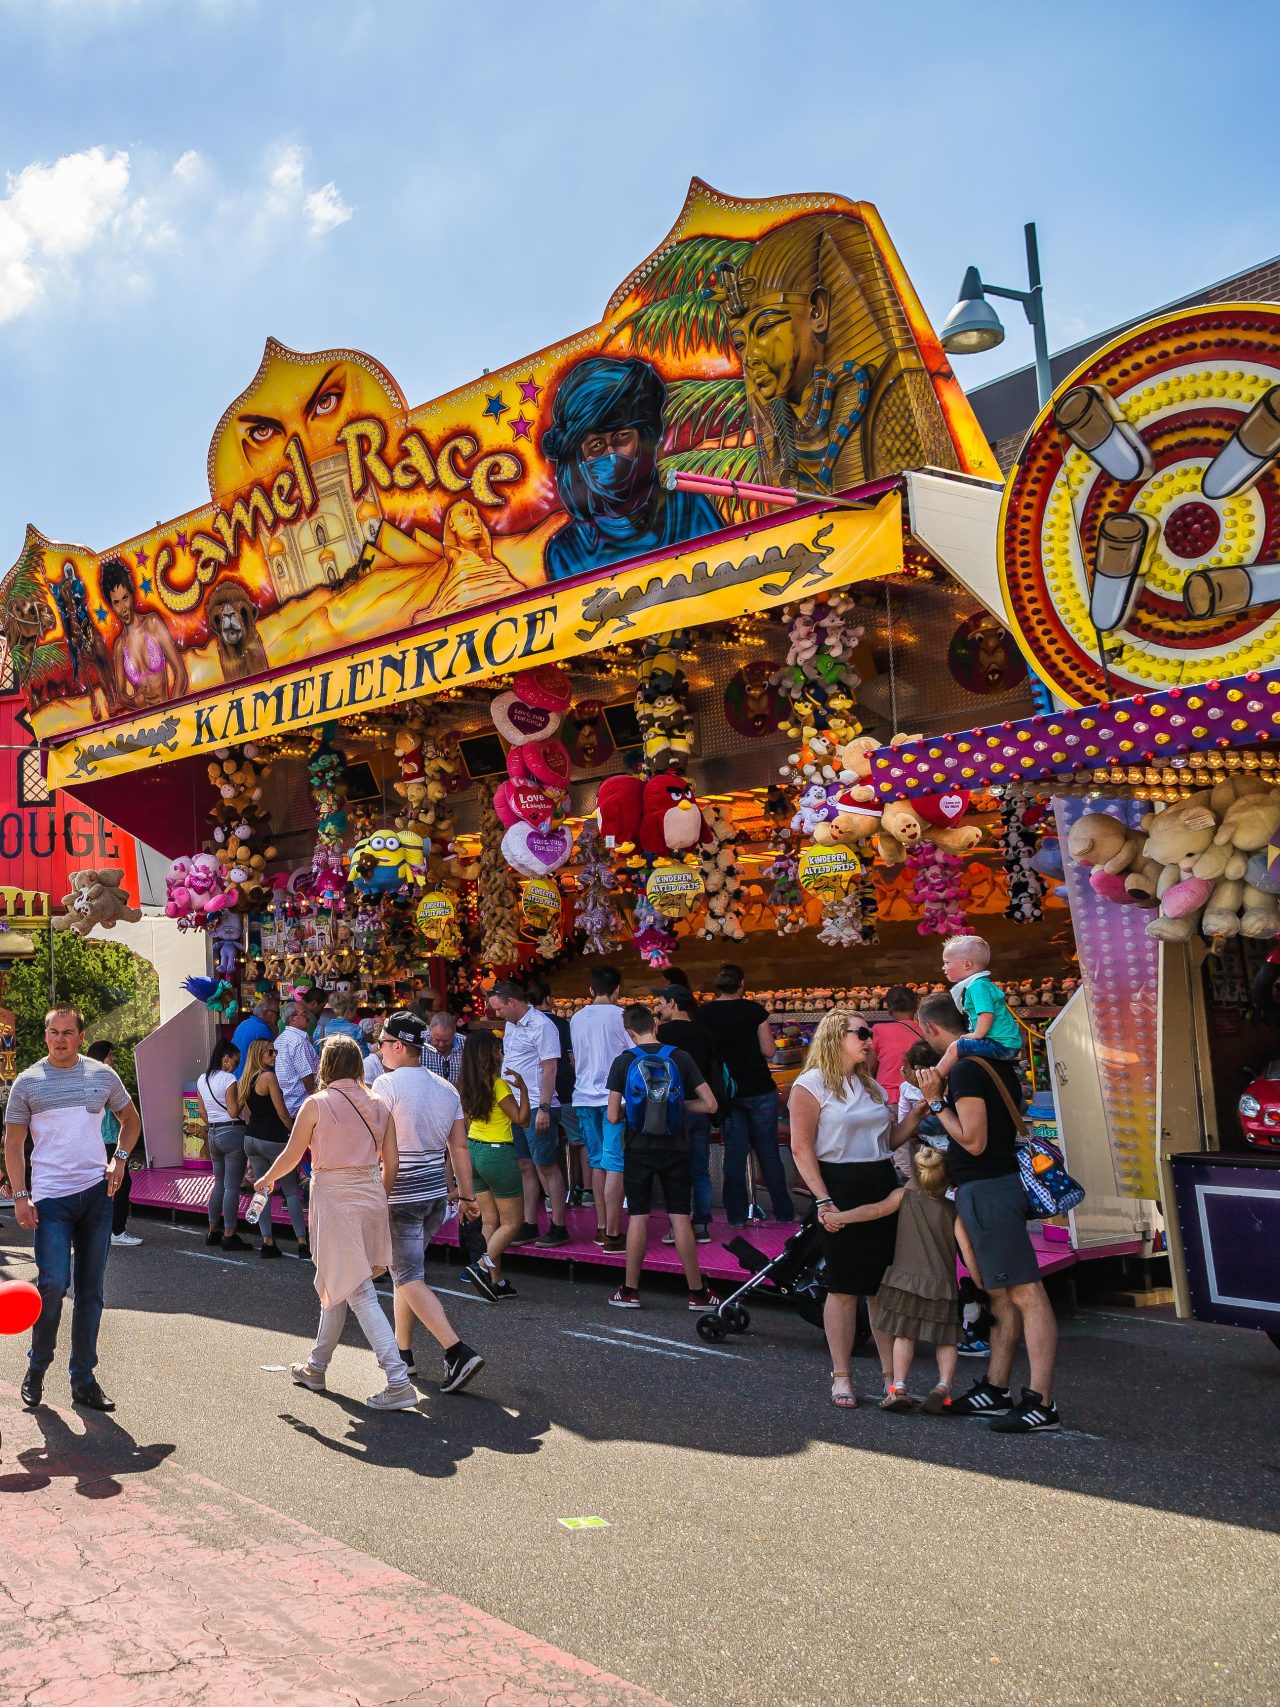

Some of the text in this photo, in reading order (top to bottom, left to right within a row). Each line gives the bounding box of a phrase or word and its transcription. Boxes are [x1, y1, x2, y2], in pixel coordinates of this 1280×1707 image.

[155, 418, 523, 613] Camel Race
[191, 605, 558, 747] KAMELENRACE
[519, 793, 545, 804] Love
